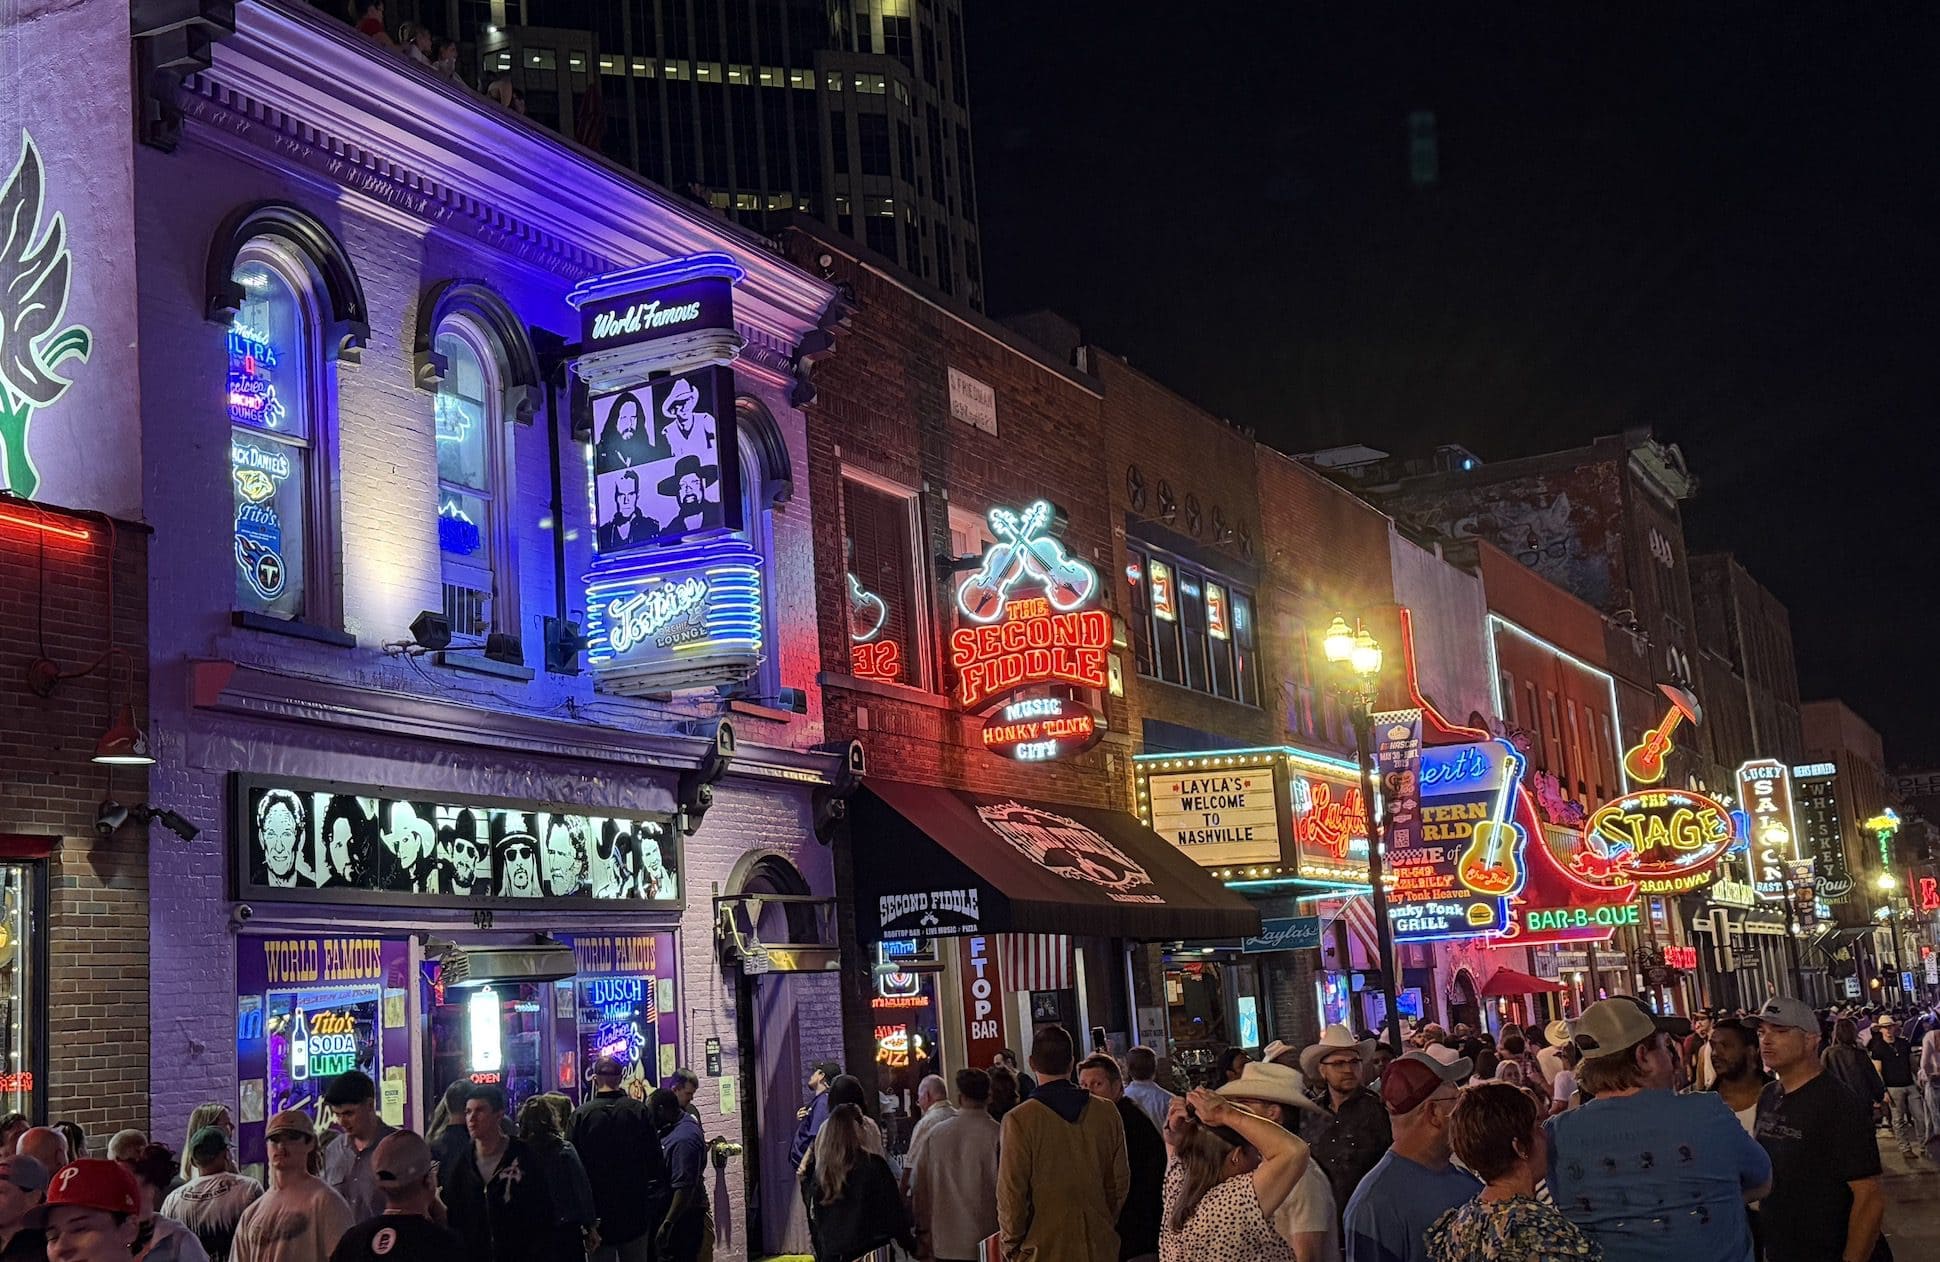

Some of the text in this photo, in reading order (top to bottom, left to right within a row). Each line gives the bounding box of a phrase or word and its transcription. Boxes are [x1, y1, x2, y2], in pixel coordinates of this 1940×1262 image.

[592, 300, 700, 339] World Famous
[230, 405, 263, 422] OUNGE
[1005, 598, 1049, 621] THE
[657, 626, 708, 649] LOUNGE
[951, 611, 1108, 667] SECOND
[961, 647, 1105, 705] FIDDLE
[1006, 699, 1063, 721] MUSIC
[983, 716, 1091, 744] HONKY TONK
[1016, 739, 1057, 760] CITY
[1741, 767, 1783, 781] LUCKY
[1181, 778, 1243, 794] LAYLA'S
[1181, 794, 1246, 811] WELCOME
[1640, 794, 1669, 808] THE
[1202, 813, 1221, 827] TO
[1594, 807, 1729, 854] STAGE
[1809, 784, 1835, 876] WHISKEY
[1178, 827, 1254, 845] NASHVILLE
[1432, 889, 1472, 900] Heaven
[880, 888, 980, 928] SECOND FIDDLE
[1426, 902, 1465, 917] Tonk
[1527, 904, 1641, 931] BAR-B-QUE
[473, 910, 494, 930] 422
[1397, 916, 1449, 932] GRILL
[263, 938, 382, 983] WORLD FAMOUS
[573, 936, 656, 972] WORLD FAMOUS
[594, 979, 643, 1005] BUSCH
[970, 1020, 998, 1040] BAR
[309, 1034, 357, 1055] SODA
[309, 1053, 357, 1077] LIME
[470, 1072, 501, 1084] OPEN
[59, 1167, 79, 1192] P
